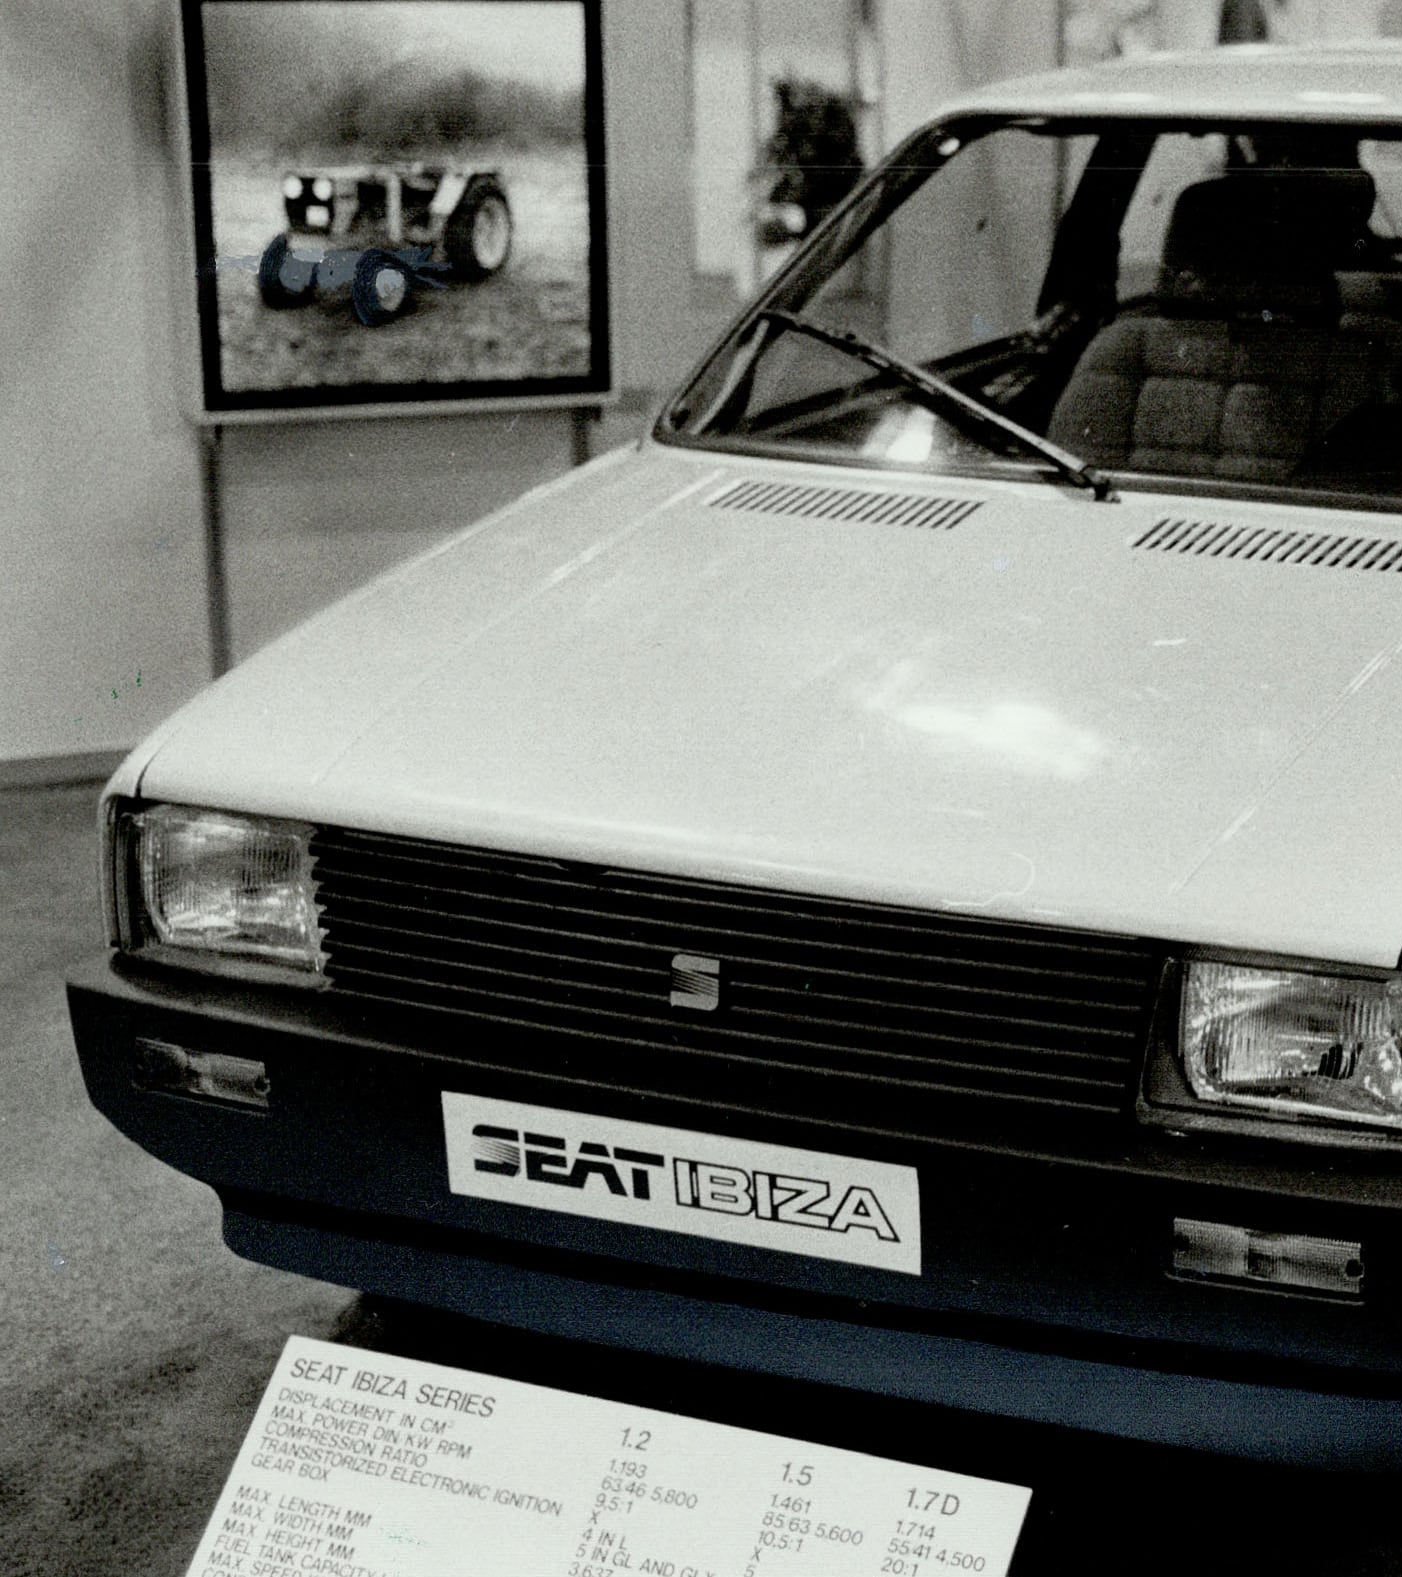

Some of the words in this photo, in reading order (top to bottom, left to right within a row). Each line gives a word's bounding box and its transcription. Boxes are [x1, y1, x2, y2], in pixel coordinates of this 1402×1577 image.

[471, 1123, 665, 1200] SEAT
[672, 1156, 901, 1243] IBIZA
[290, 1357, 348, 1386] SEAT
[352, 1370, 407, 1400] IBIZA
[415, 1383, 497, 1419] SERIES
[278, 1387, 395, 1424] DISPLACEMENT
[400, 1412, 416, 1429] IN
[265, 1420, 377, 1457] COMPRESSION
[380, 1445, 428, 1468] RATIO
[312, 1413, 369, 1437] POWER
[373, 1426, 400, 1444] DIN
[405, 1433, 432, 1451] KW
[438, 1439, 473, 1460] RPM
[621, 1427, 651, 1451] 1.2
[250, 1452, 295, 1473] GEAR
[298, 1463, 333, 1483] BOX
[259, 1435, 388, 1477] TRANSISTORIZED
[390, 1466, 490, 1500] ELECTRONIC
[493, 1489, 563, 1517] IGNITION
[609, 1459, 648, 1479] 1.193
[780, 1461, 814, 1486] 1.5
[273, 1511, 324, 1534] WIDTH
[326, 1523, 354, 1541] MM
[277, 1494, 342, 1521] LENGTH
[343, 1509, 373, 1528] MM
[588, 1509, 601, 1525] X
[264, 1528, 324, 1552] HEIGHT
[326, 1542, 355, 1560] MM
[582, 1528, 593, 1542] 4
[598, 1529, 616, 1547] IN
[619, 1535, 628, 1551] L
[895, 1520, 936, 1541] 1.714
[213, 1534, 251, 1556] FUEL
[258, 1544, 296, 1566] TANK
[576, 1543, 588, 1558] 5
[591, 1547, 610, 1563] IN
[612, 1550, 633, 1569] GL
[639, 1558, 676, 1577] AND
[750, 1546, 762, 1563] X
